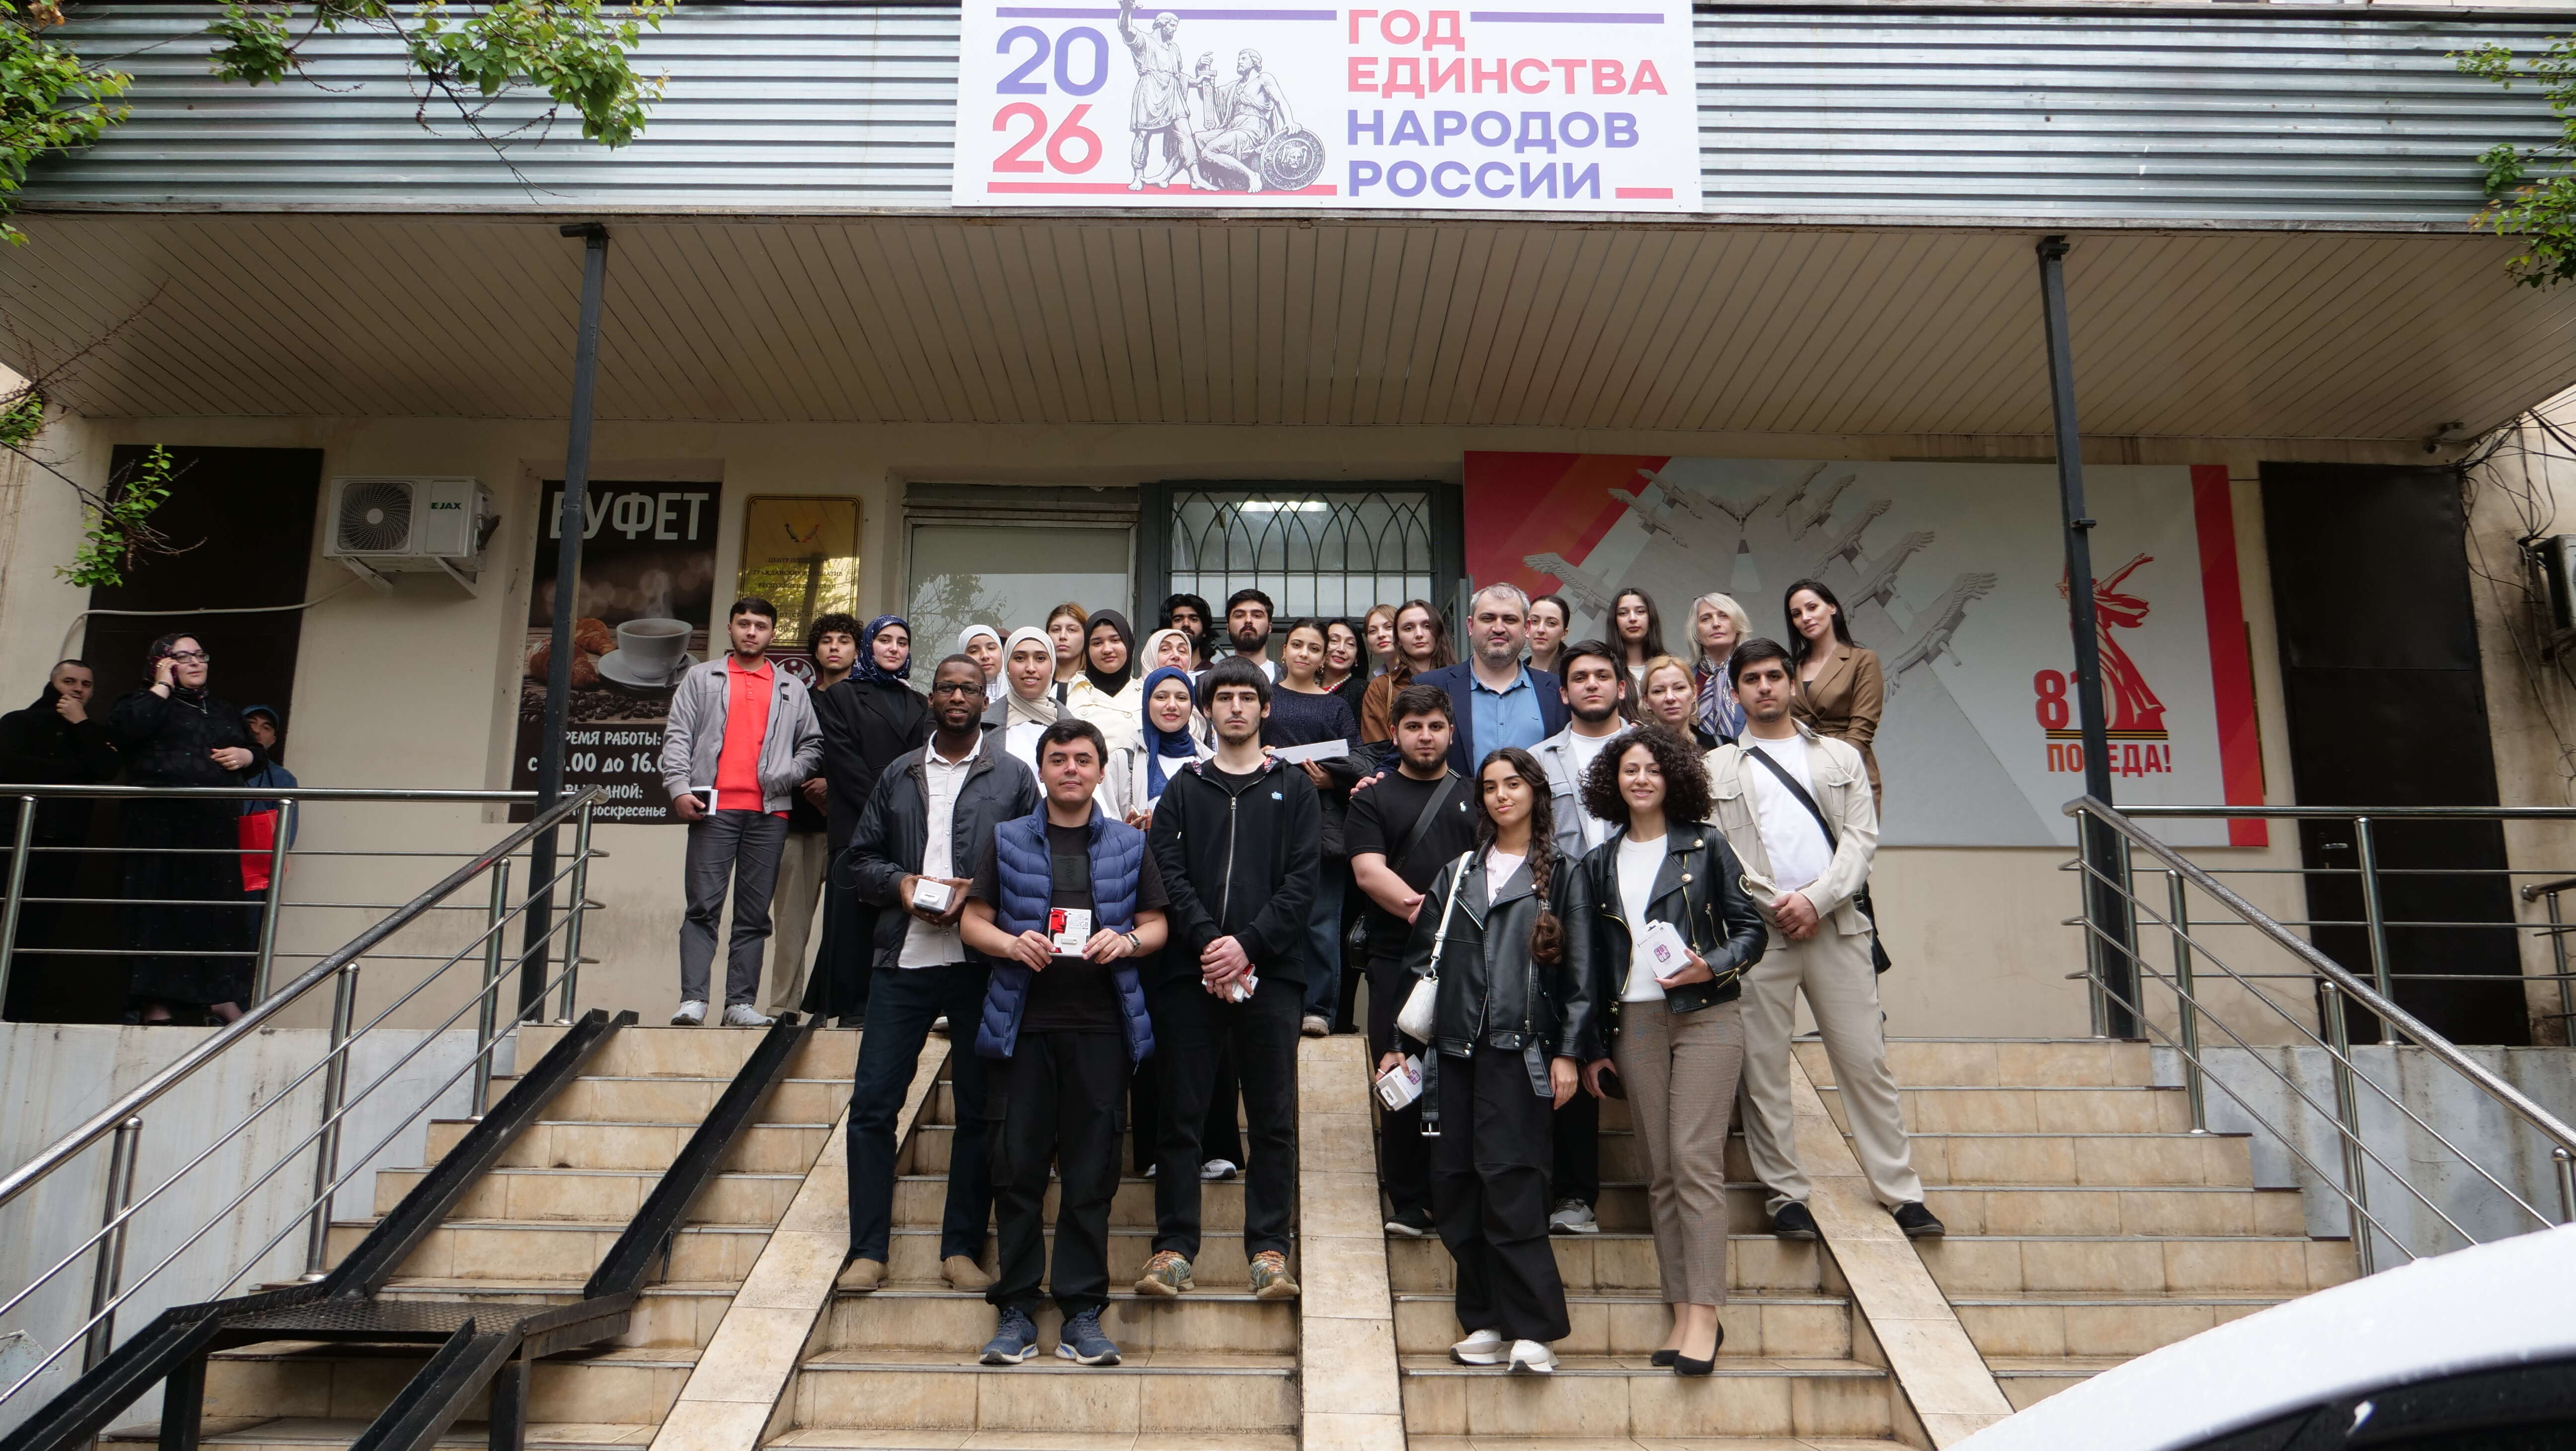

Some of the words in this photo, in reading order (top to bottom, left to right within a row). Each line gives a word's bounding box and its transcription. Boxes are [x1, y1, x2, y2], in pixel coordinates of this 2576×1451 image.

[1349, 9, 1465, 51] ГОД
[997, 26, 1108, 96] 20
[1348, 57, 1668, 99] ЕДИНСТВА
[993, 102, 1103, 174] 26
[1348, 110, 1639, 154] НАРОДОВ
[1349, 160, 1600, 199] РОССИИ
[565, 731, 601, 745] РЕМЯ
[604, 731, 661, 745] РАБОТЫ:
[602, 757, 625, 773] до
[2046, 743, 2172, 777] ПОЕДА!
